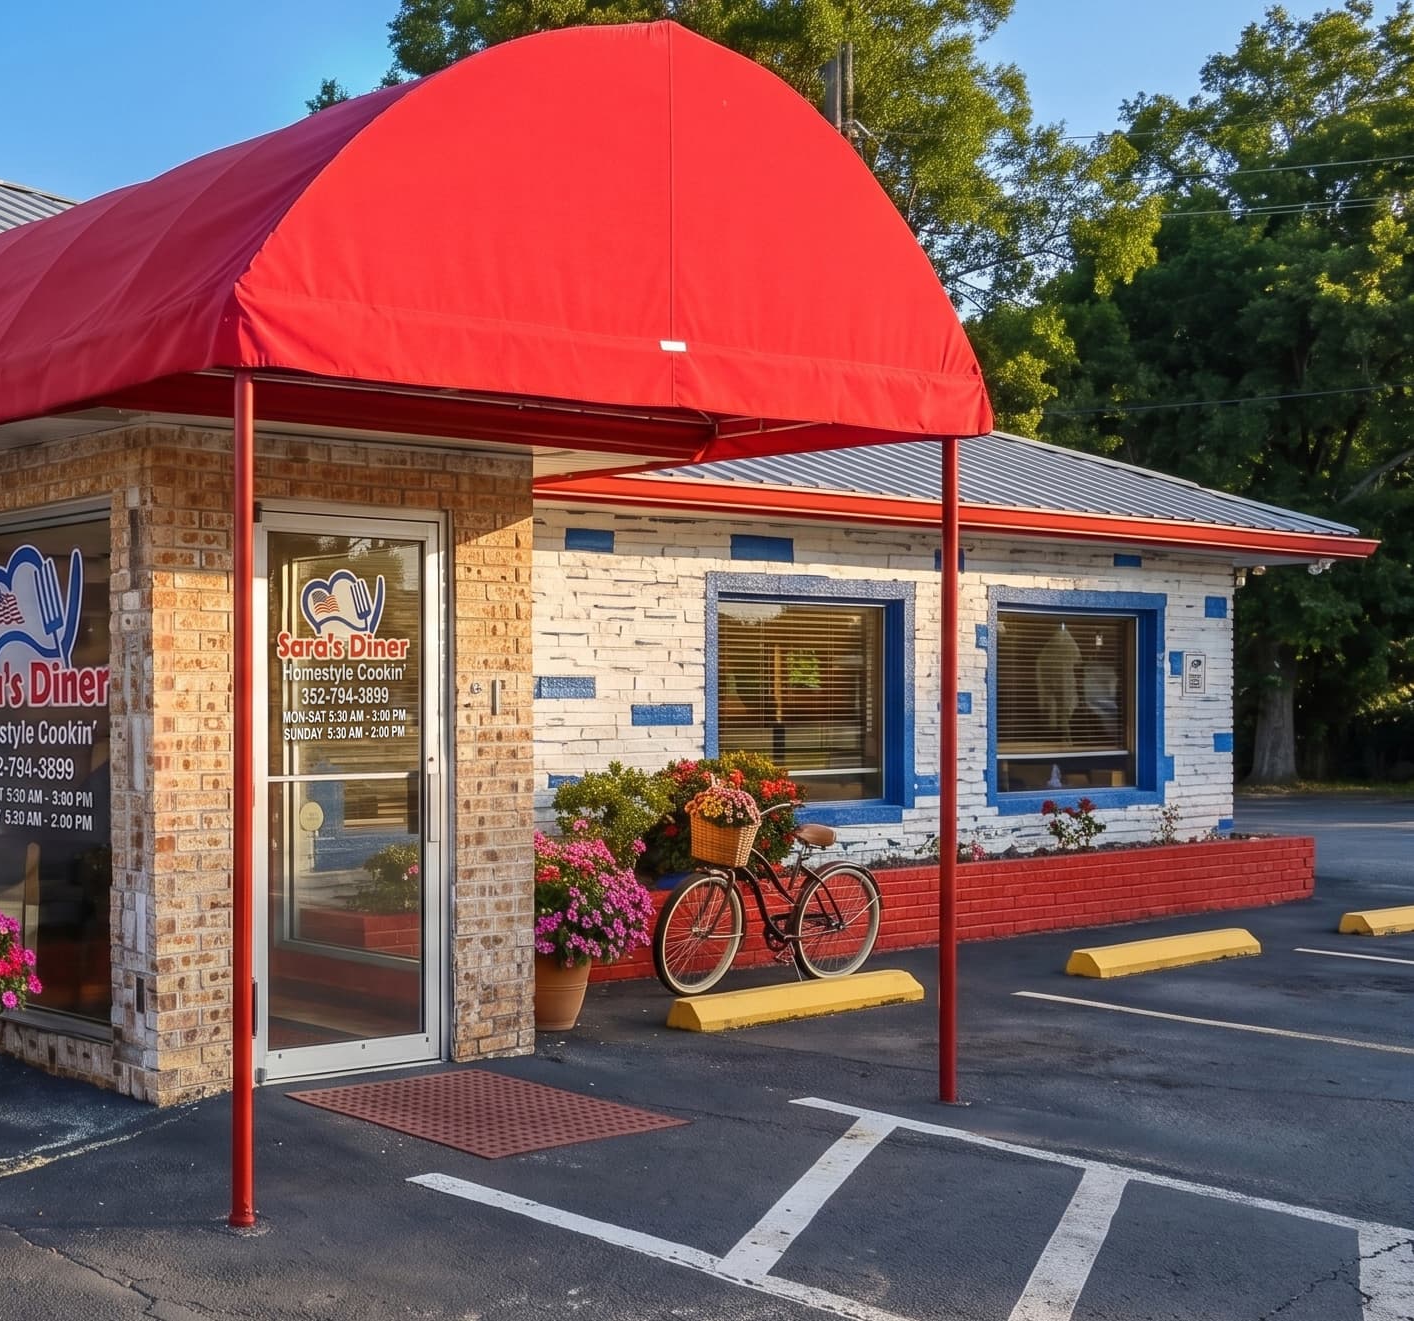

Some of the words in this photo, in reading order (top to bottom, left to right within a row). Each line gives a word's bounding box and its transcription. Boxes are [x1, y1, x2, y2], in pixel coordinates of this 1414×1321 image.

[278, 632, 344, 659] Sara's
[349, 633, 409, 659] Diner
[30, 661, 109, 706] Diner
[283, 663, 354, 685] Homestyle
[357, 663, 406, 681] Cookin'
[301, 686, 389, 705] 352-794-3899
[283, 710, 327, 724] MON-SAT
[328, 710, 347, 723] 5:30
[349, 710, 364, 722] AM
[372, 709, 390, 721] 3:00
[392, 709, 406, 721] PM
[38, 720, 97, 745] Cookin'
[284, 727, 323, 741] SUNDAY
[327, 727, 346, 739] 5:30
[348, 726, 363, 738] AM
[370, 726, 389, 738] 2:00
[391, 725, 405, 737] PM
[28, 789, 43, 804] AM
[76, 792, 93, 808] PM
[26, 811, 42, 826] AM
[75, 815, 93, 831] PM
